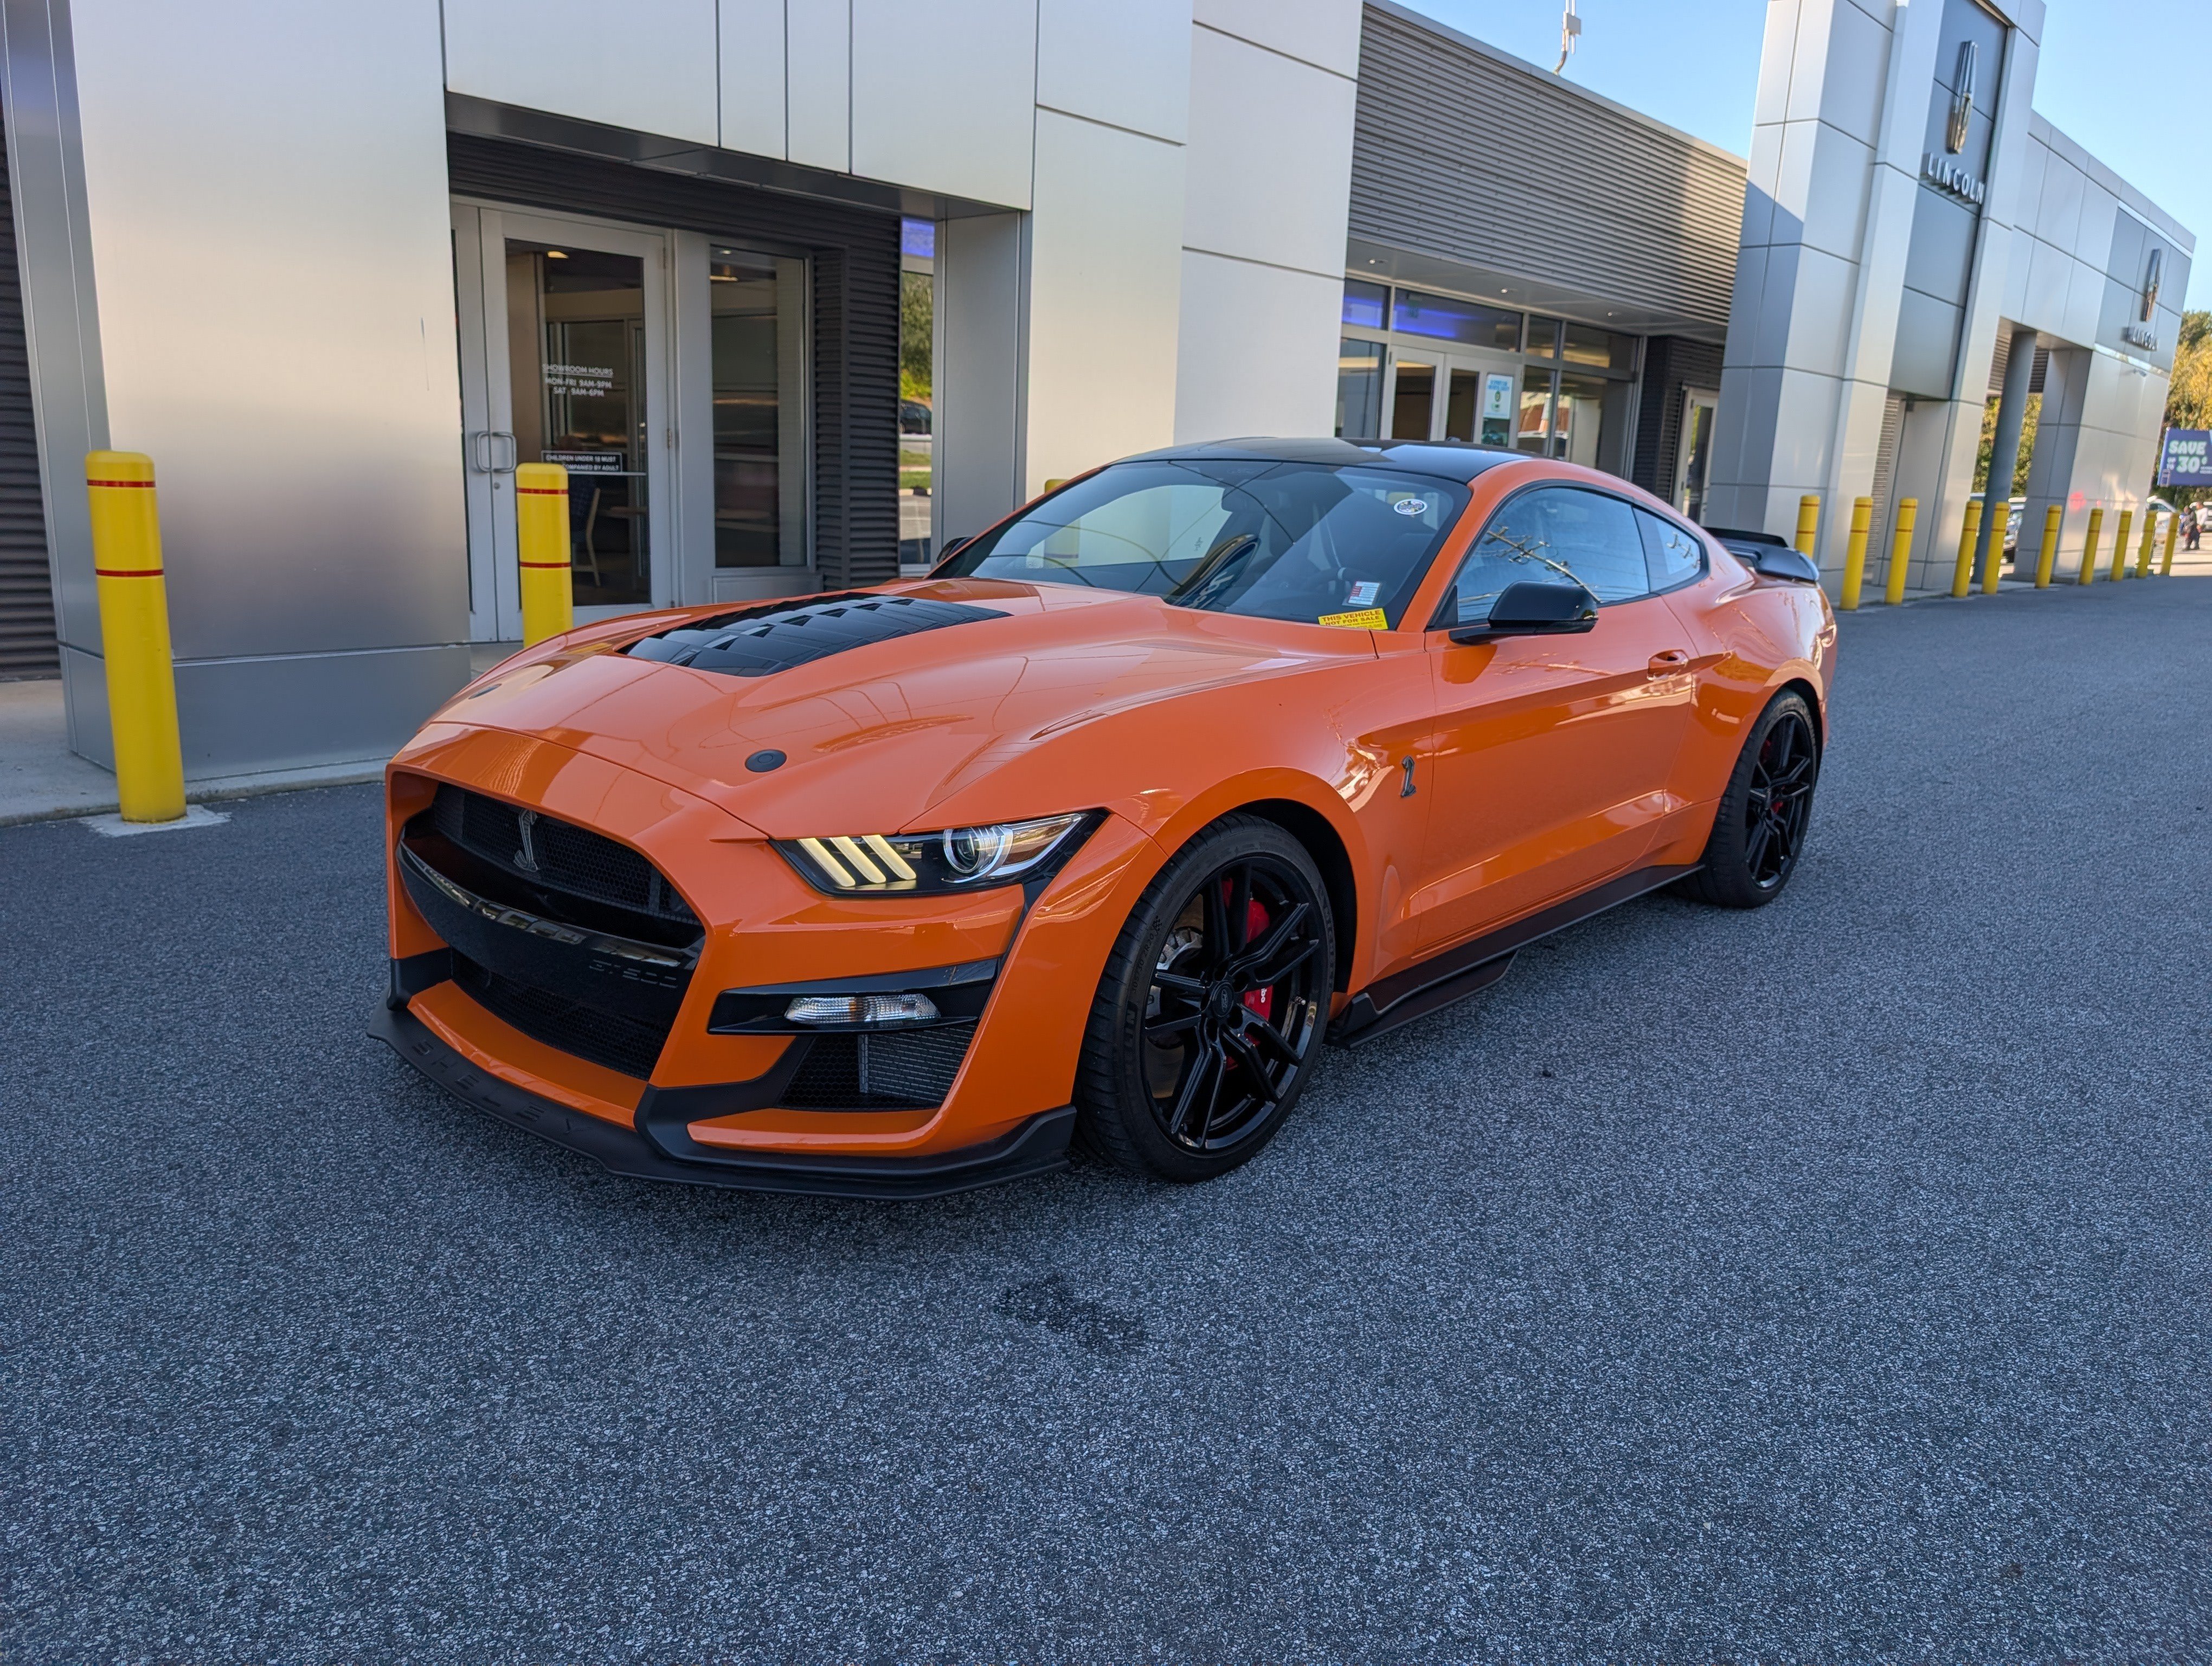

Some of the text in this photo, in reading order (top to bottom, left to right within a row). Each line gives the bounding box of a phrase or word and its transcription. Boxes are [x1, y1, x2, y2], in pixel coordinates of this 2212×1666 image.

[1928, 152, 1984, 204] LINCOLN
[542, 364, 613, 376] SHOWROOM HOURS
[544, 377, 576, 386] MON-FRI
[553, 386, 566, 394] SAT
[2169, 440, 2207, 455] SAVE
[1343, 610, 1380, 619] VEHICLE
